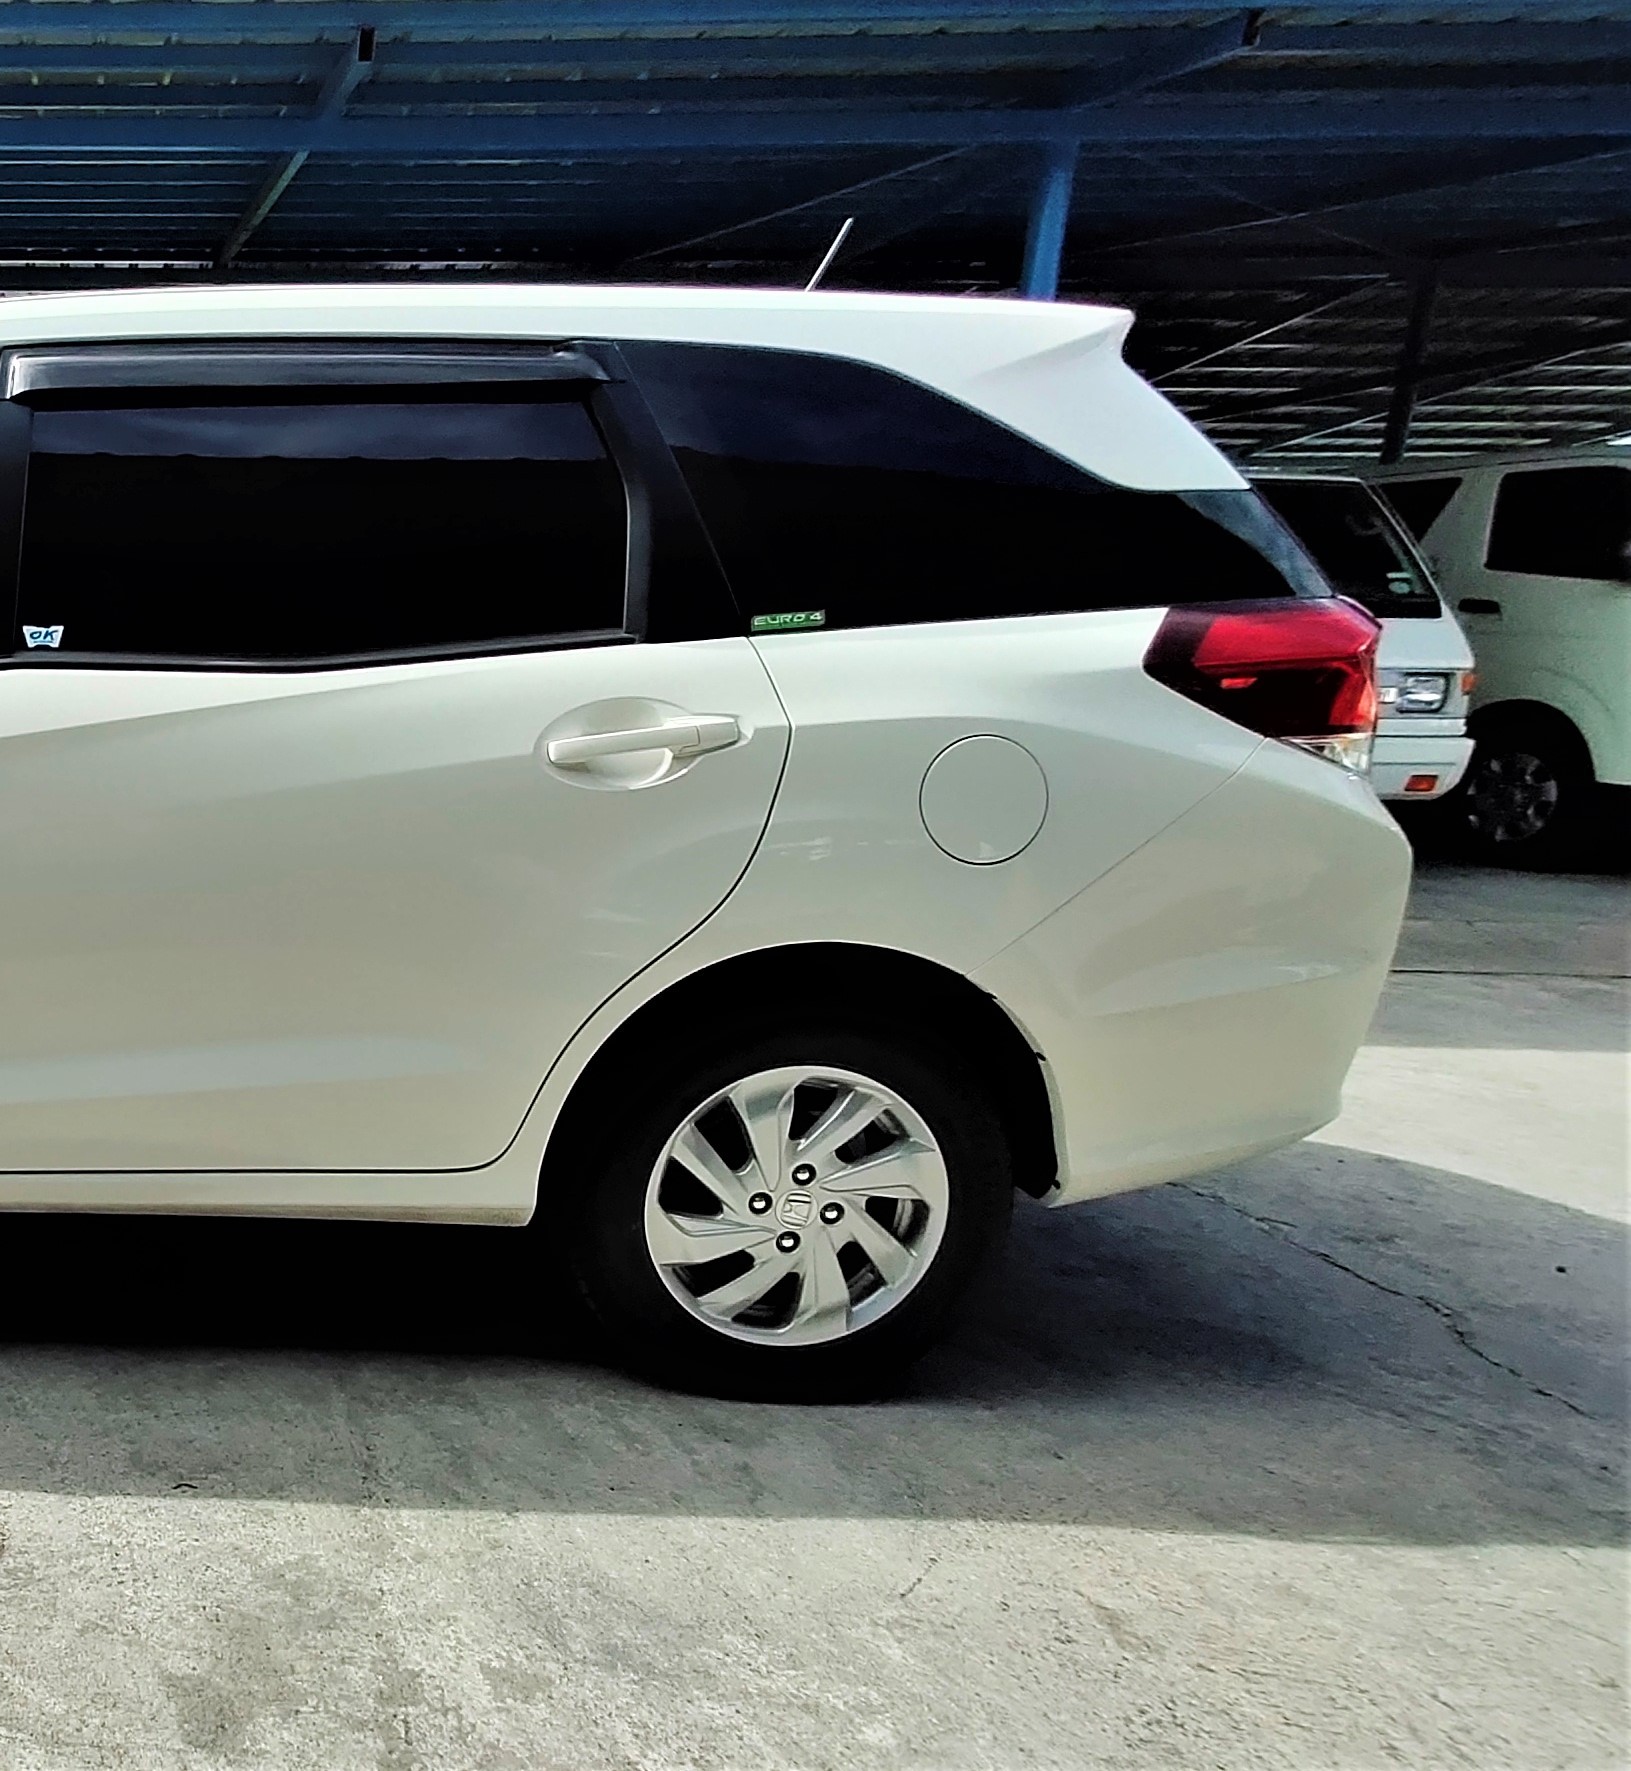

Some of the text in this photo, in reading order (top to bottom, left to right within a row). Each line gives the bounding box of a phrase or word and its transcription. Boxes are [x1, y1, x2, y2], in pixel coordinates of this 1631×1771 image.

[754, 612, 822, 625] EURO 4
[29, 629, 59, 641] OK
